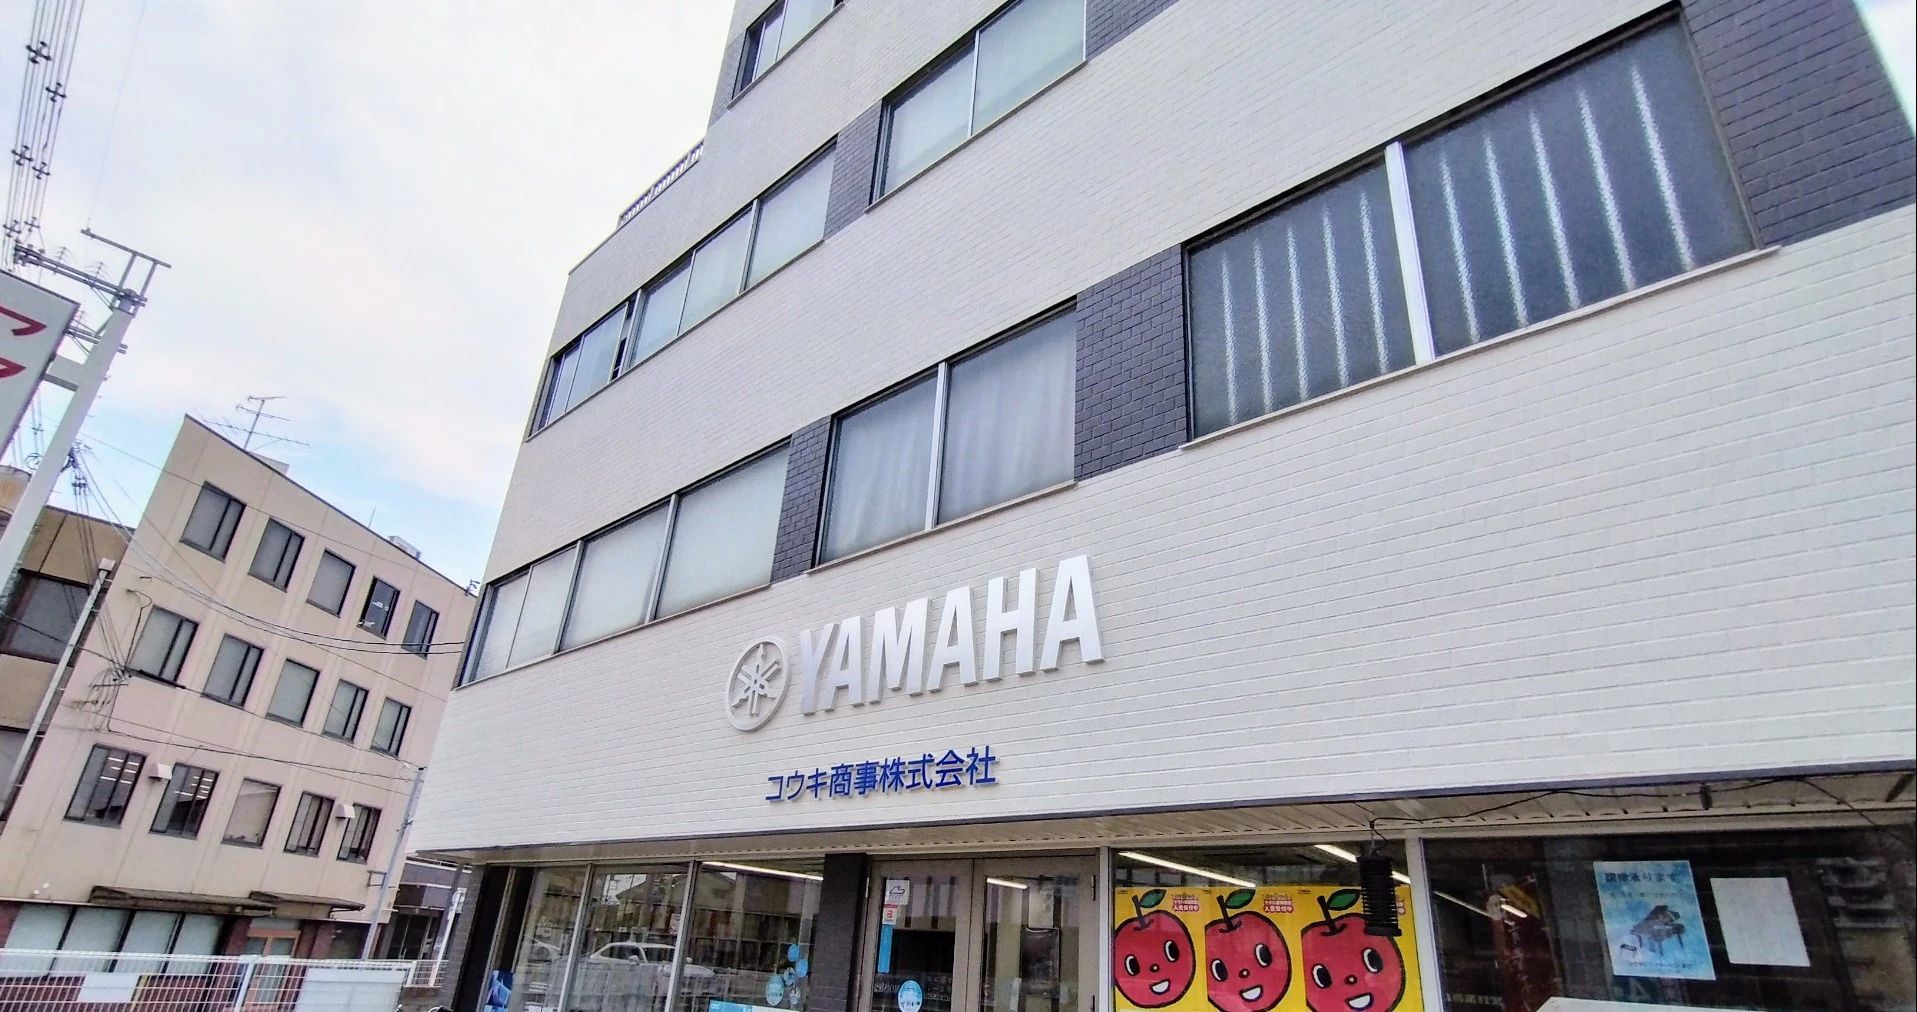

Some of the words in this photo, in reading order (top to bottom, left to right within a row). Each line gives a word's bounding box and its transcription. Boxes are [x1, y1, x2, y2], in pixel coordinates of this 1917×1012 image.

[800, 555, 1104, 715] YAMAHA
[766, 745, 997, 801] コウキ商事株式会社
